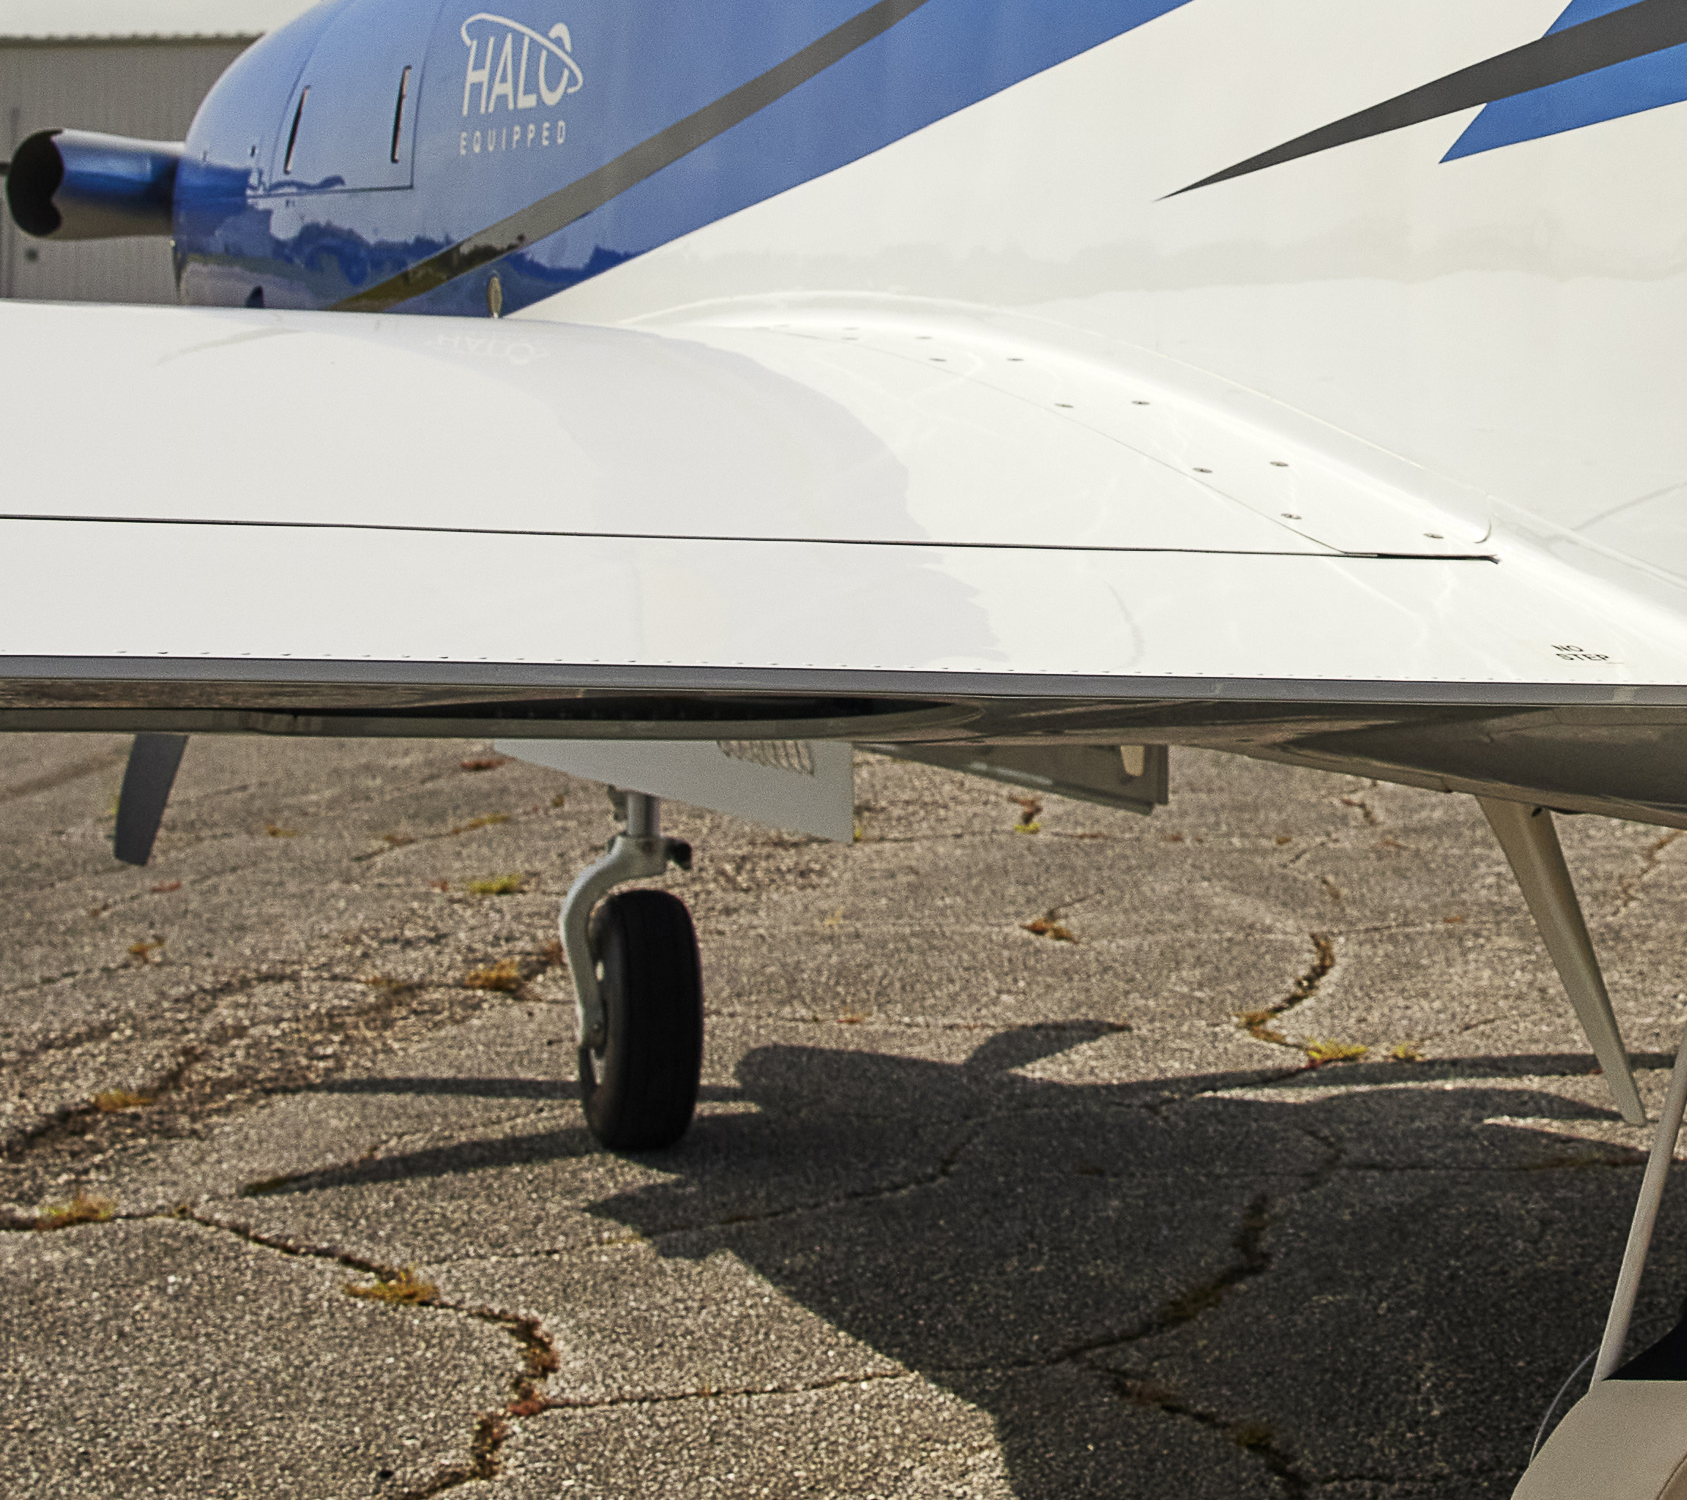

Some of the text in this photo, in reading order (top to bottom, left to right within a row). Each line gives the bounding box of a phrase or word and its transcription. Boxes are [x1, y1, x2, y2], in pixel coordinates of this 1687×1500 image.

[461, 13, 583, 117] HALO
[460, 120, 566, 156] EQUIPPED
[1551, 644, 1584, 652] NO
[1555, 653, 1609, 661] STEP
